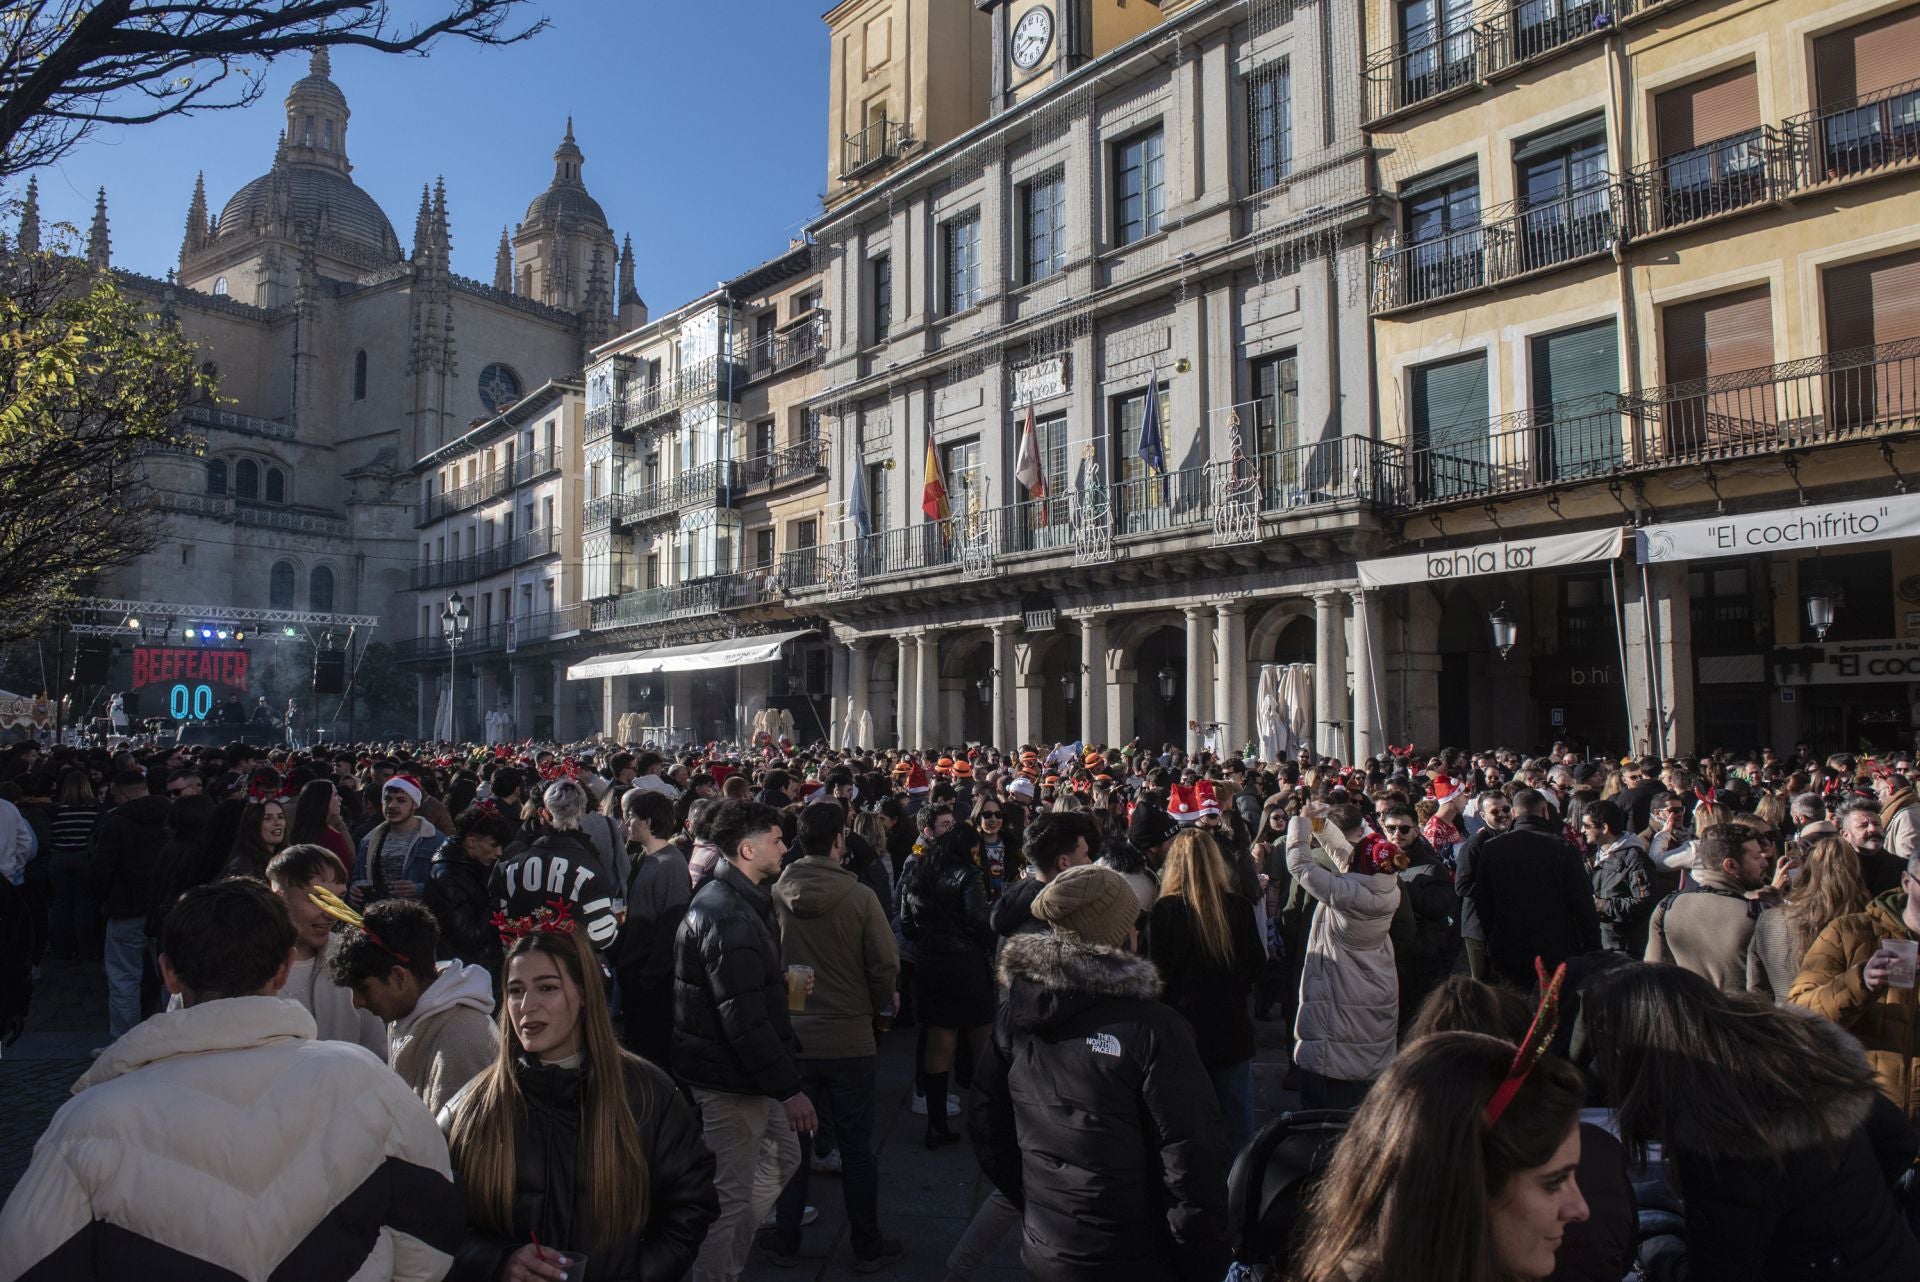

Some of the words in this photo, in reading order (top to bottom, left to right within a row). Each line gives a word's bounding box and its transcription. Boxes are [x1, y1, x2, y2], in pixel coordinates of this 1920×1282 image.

[1021, 360, 1058, 383] PLAZA
[1746, 506, 1888, 545] cochifrito"
[1427, 547, 1496, 579] bahía
[1504, 543, 1536, 570] bar
[133, 648, 248, 692] BEEFEATER
[170, 684, 212, 720] 0.0
[1086, 1037, 1112, 1049] NORTH
[1092, 1045, 1111, 1054] FACE
[1097, 1032, 1111, 1041] THE
